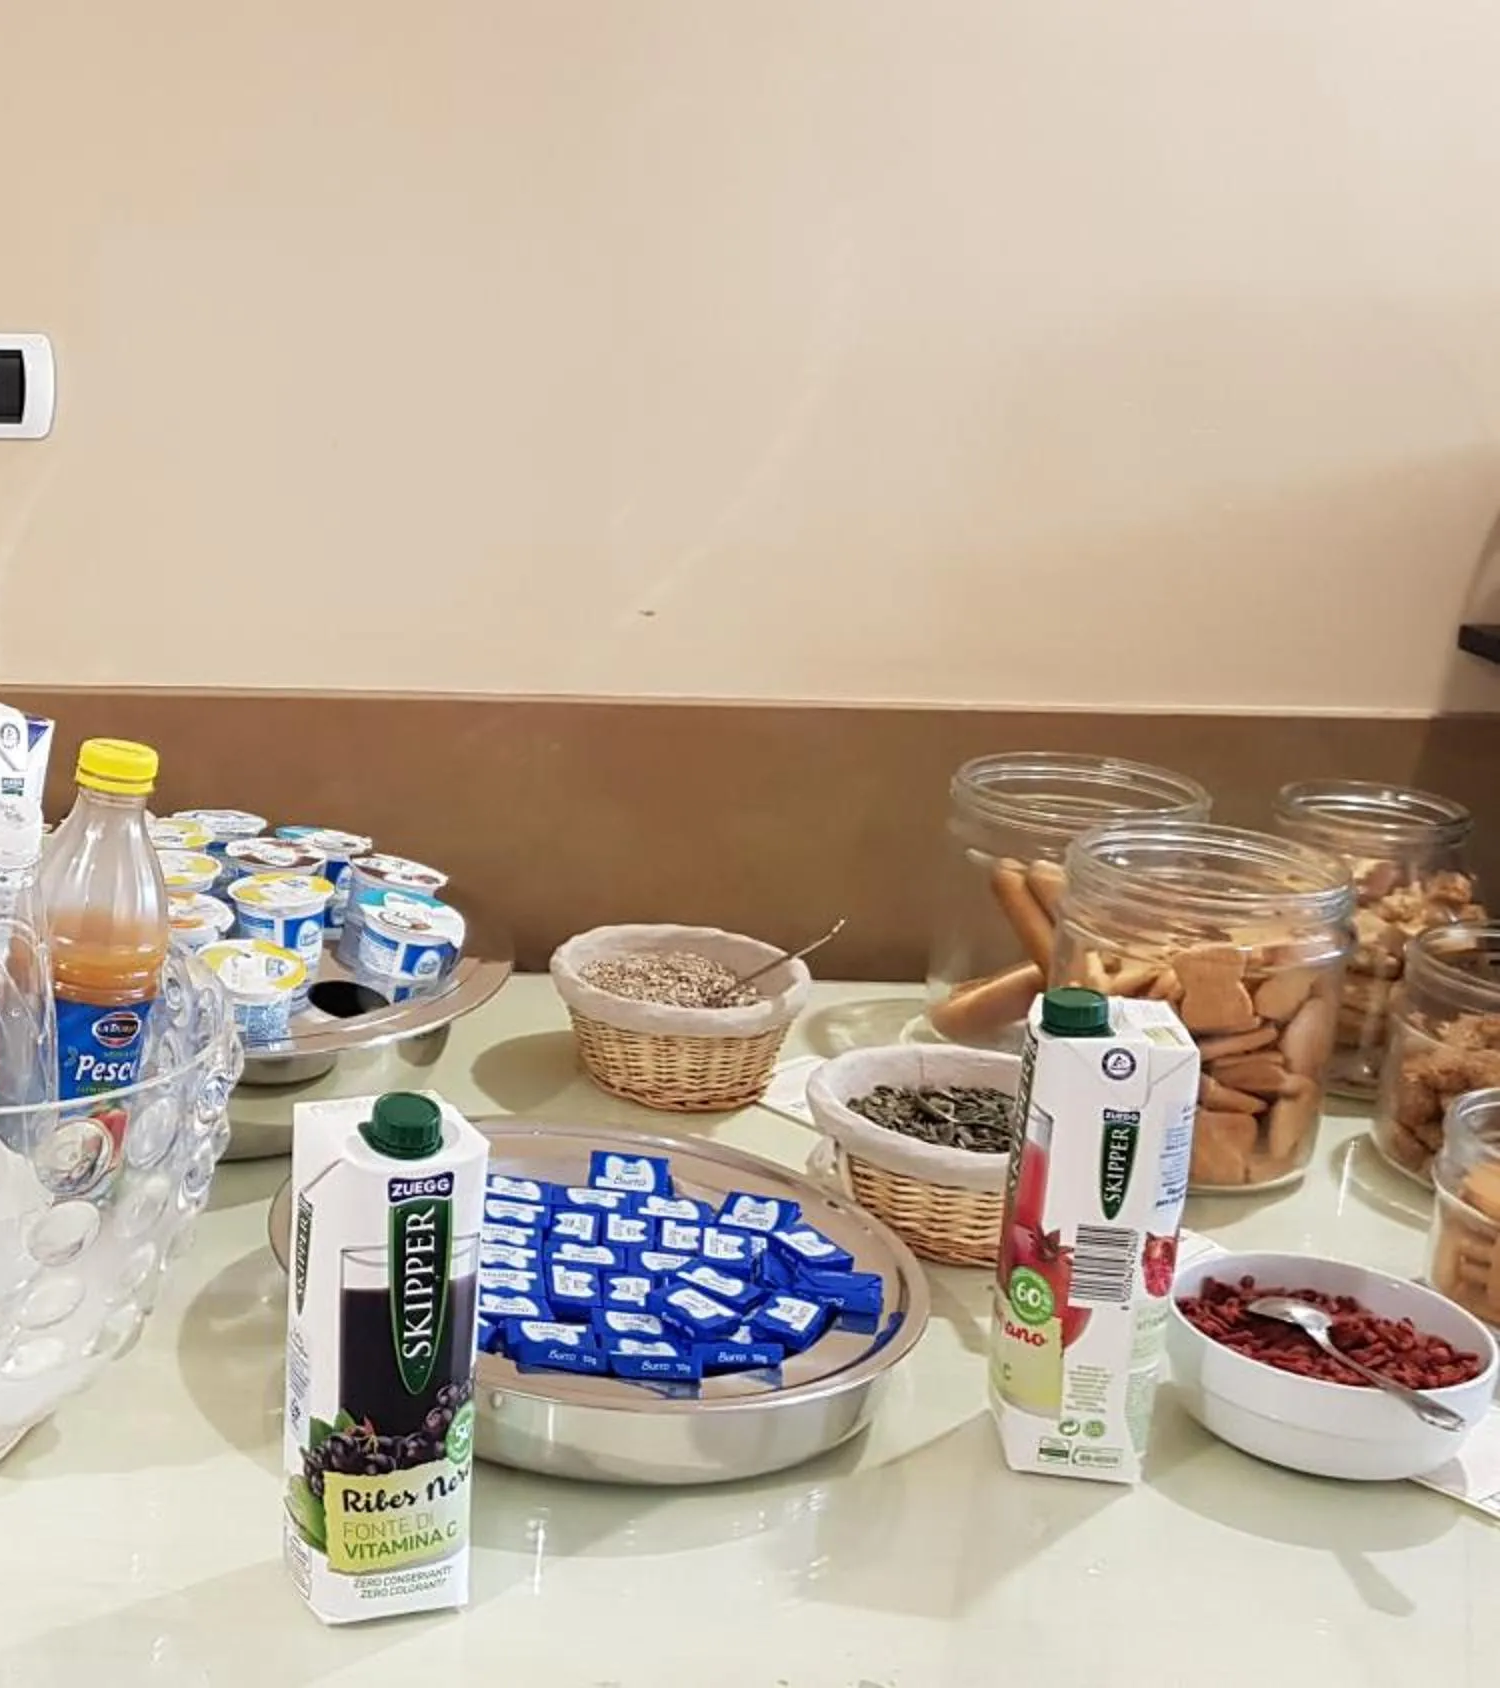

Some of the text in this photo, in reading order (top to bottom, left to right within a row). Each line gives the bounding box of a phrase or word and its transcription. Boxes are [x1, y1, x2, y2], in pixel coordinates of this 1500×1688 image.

[1104, 1127, 1131, 1203] SKIPPER
[391, 1177, 450, 1197] ZUEGG
[402, 1205, 436, 1358] SKIPPER
[342, 1488, 418, 1513] Ribes
[343, 1511, 434, 1541] FONTE DI
[344, 1520, 457, 1560] VITAMINA C
[354, 1576, 382, 1589] ZERO
[360, 1587, 388, 1599] ZERO
